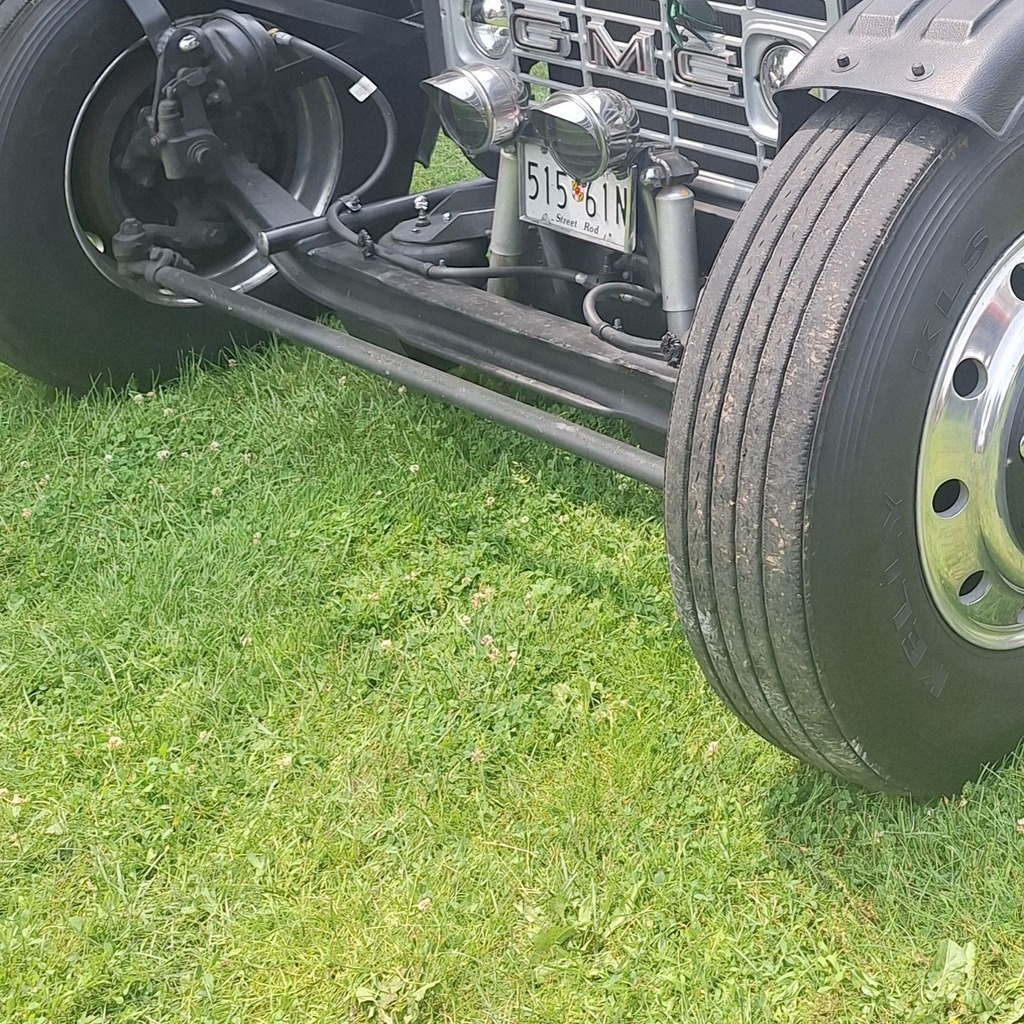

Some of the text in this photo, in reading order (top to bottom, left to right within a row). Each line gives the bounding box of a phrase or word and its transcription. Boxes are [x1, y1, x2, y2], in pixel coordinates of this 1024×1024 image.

[510, 7, 741, 96] GMC
[555, 212, 600, 235] Street Rod
